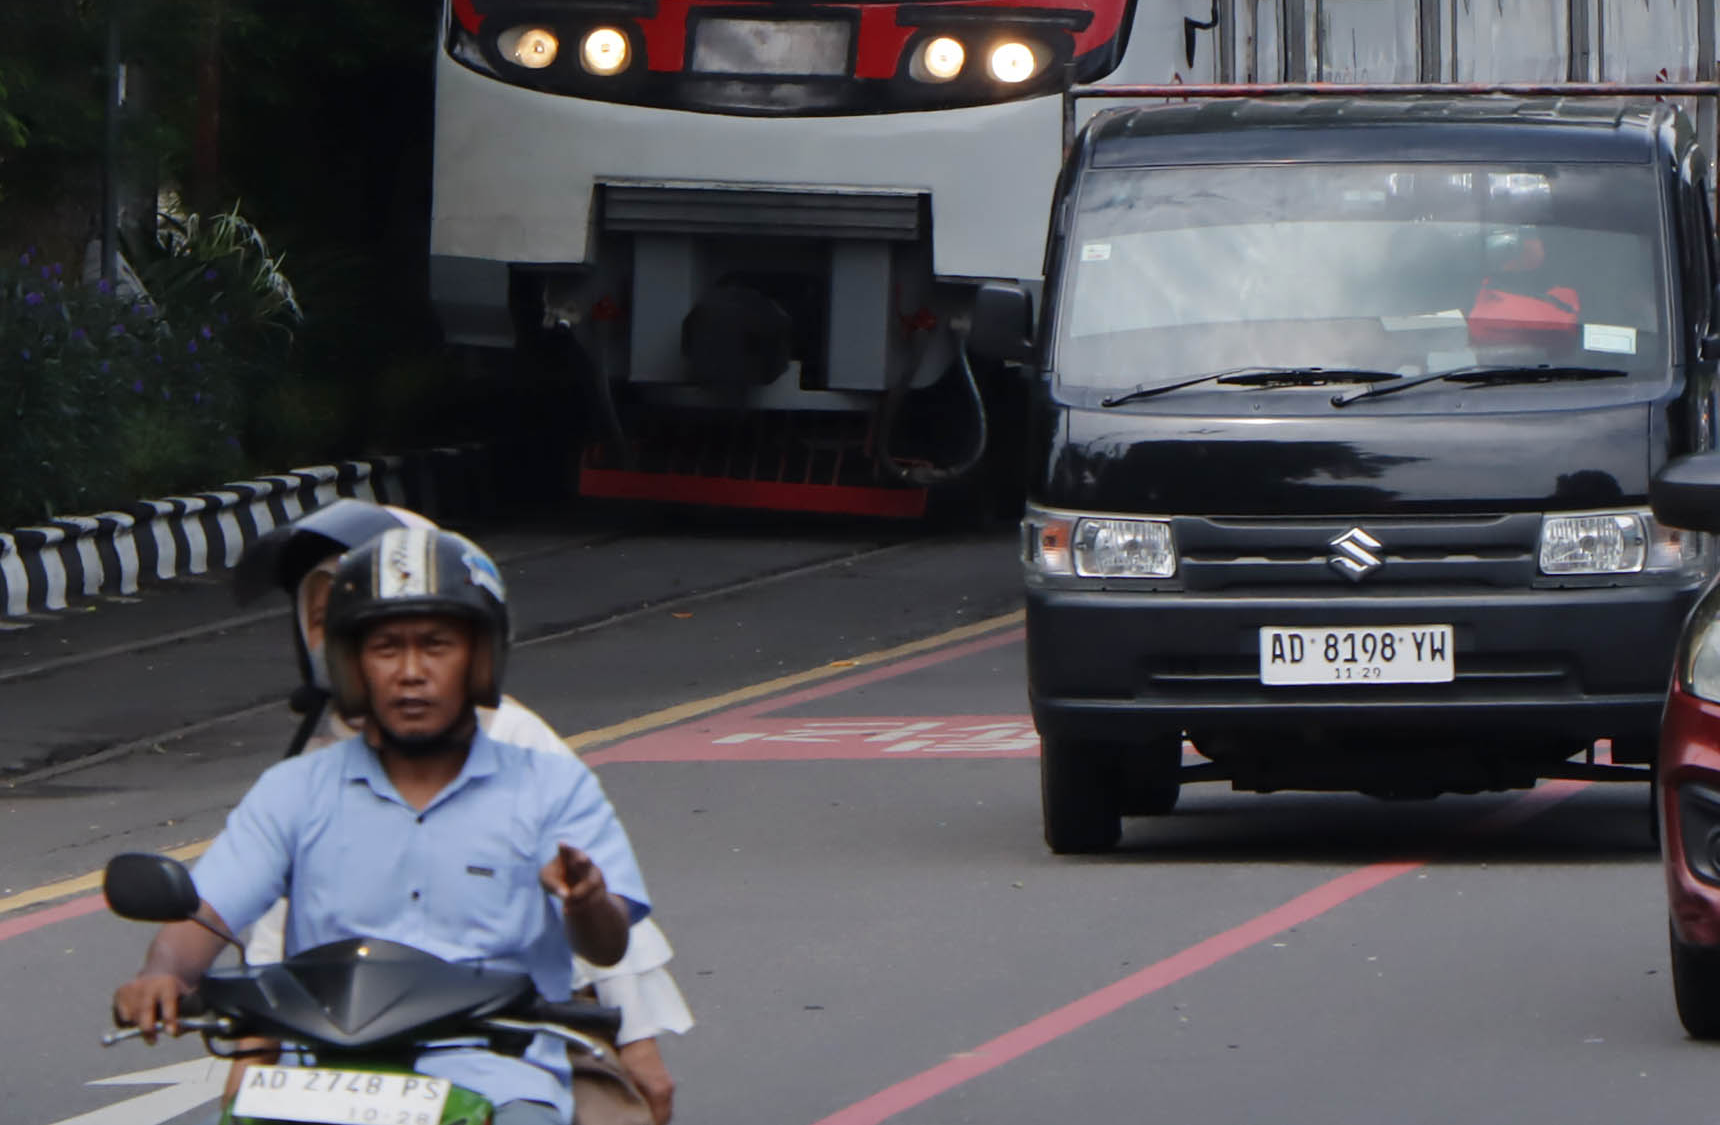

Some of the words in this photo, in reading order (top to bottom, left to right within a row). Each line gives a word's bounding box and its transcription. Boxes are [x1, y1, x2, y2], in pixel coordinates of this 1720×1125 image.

[1271, 632, 1305, 664] AD
[1323, 632, 1397, 663] 8198
[1412, 630, 1446, 662] YW
[250, 1070, 287, 1089] AD
[303, 1071, 384, 1095] 2748
[401, 1077, 440, 1101] PS
